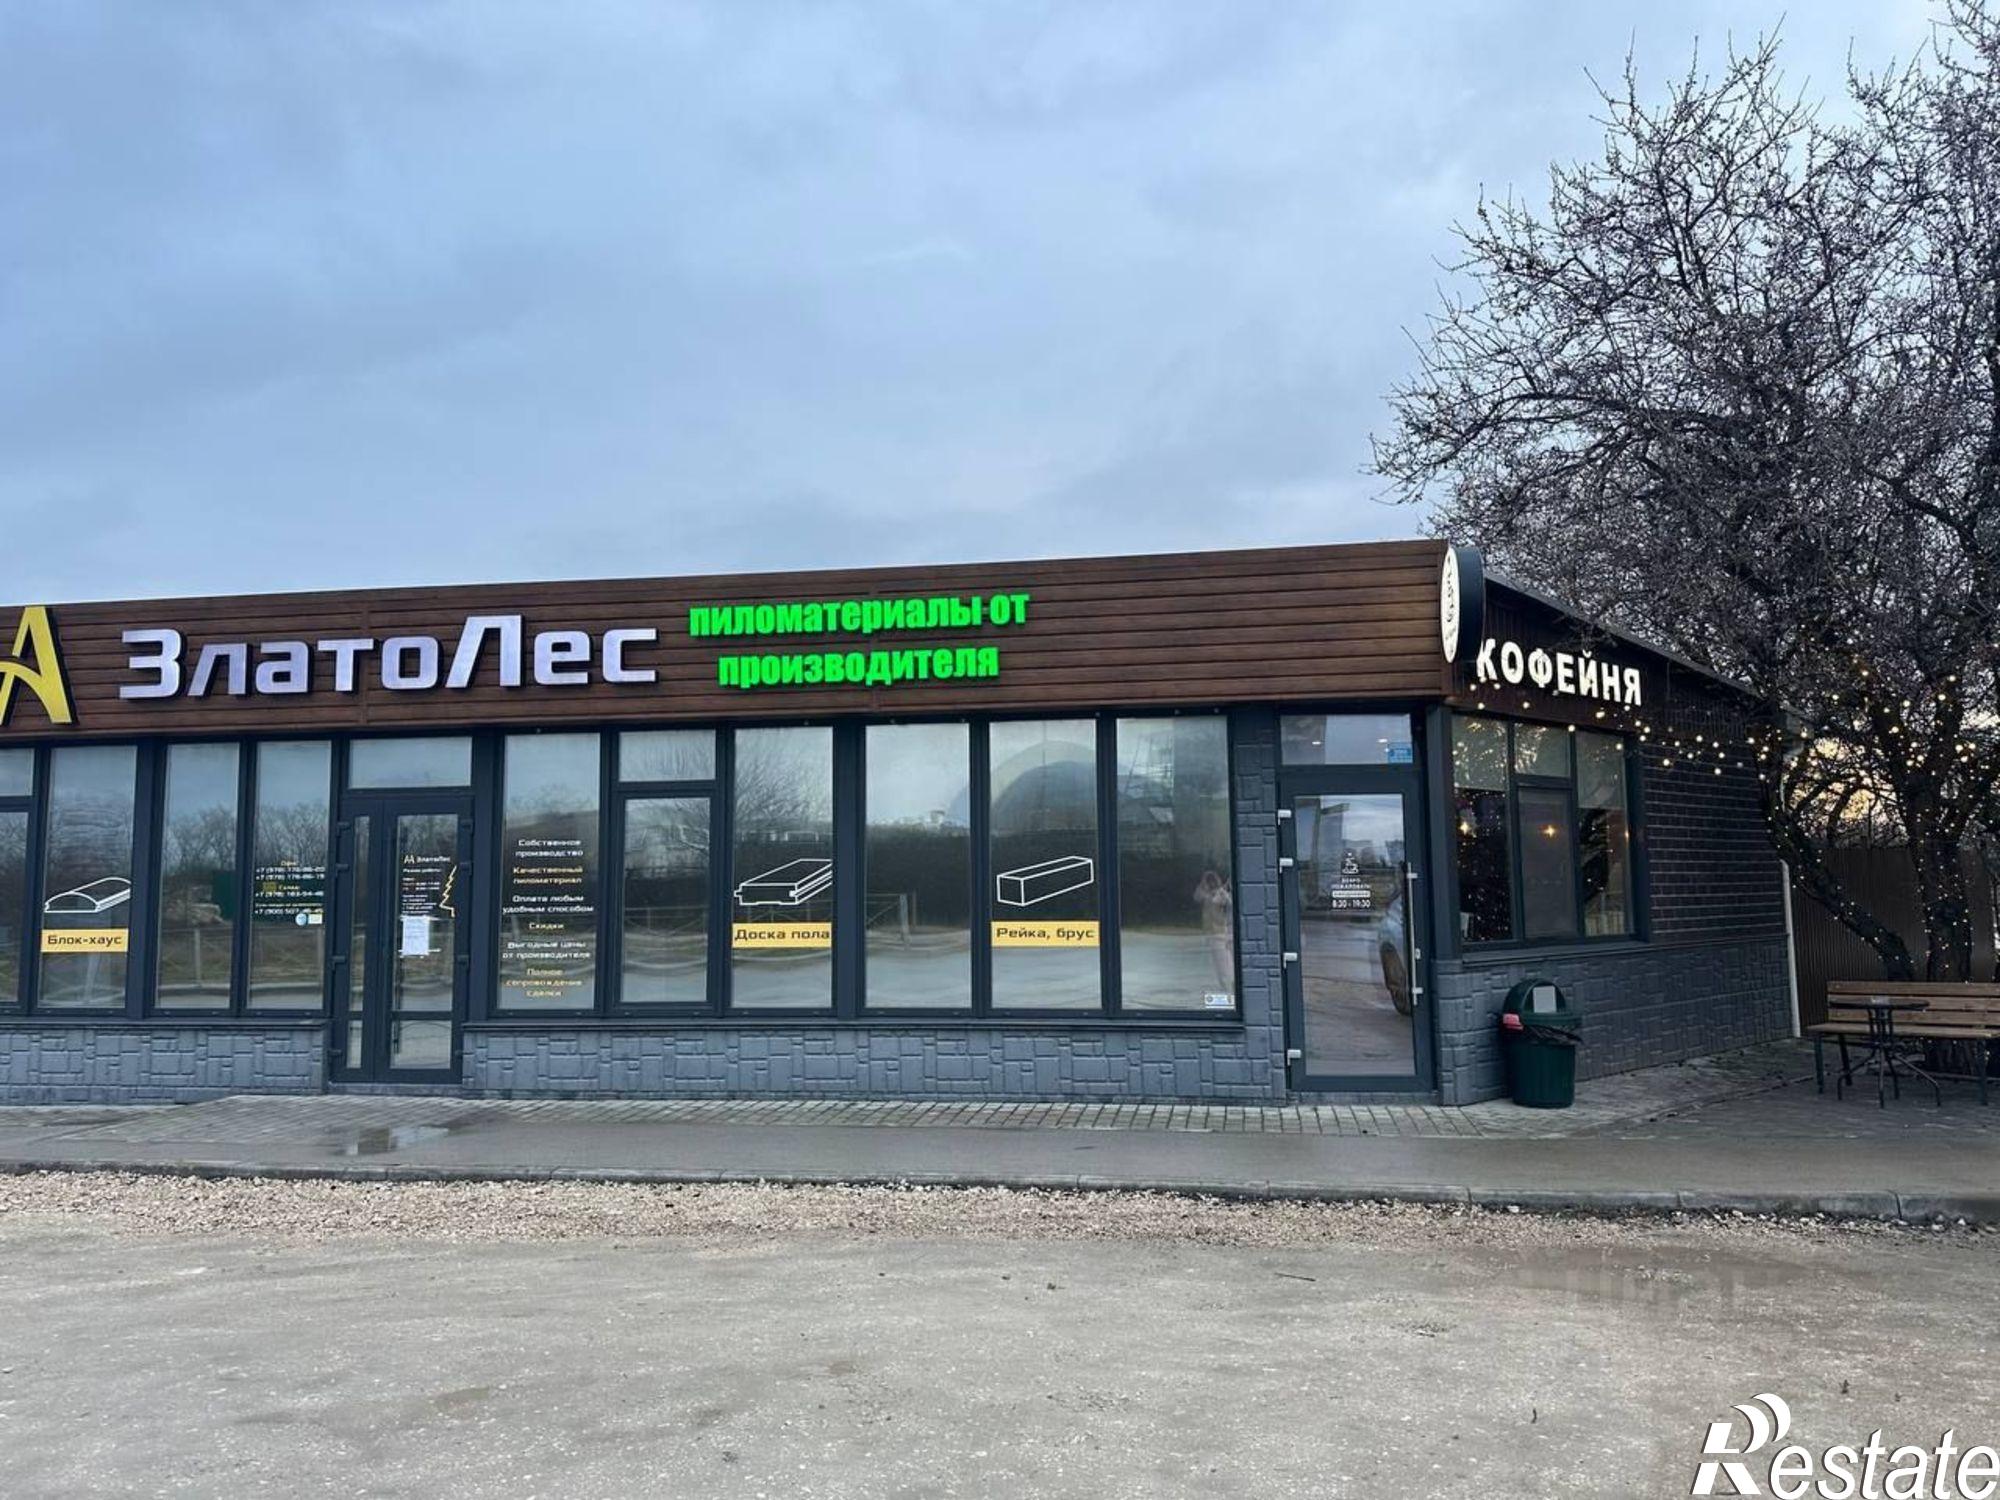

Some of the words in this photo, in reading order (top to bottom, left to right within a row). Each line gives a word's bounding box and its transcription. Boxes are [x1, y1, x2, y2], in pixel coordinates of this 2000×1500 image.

[688, 595, 983, 634] пиломатериалы
[988, 593, 1031, 626] от
[118, 613, 657, 699] ЗлатоЛес
[717, 646, 1000, 689] производителя
[1475, 637, 1643, 707] КОФЕЙНЯ
[517, 839, 582, 847] Собственное
[514, 850, 584, 859] производство
[513, 865, 584, 875] Качественный
[512, 894, 548, 903] Оплата
[549, 894, 584, 902] любым
[502, 906, 546, 915] удобным
[547, 905, 595, 914] способом
[528, 921, 564, 930] Скидки
[735, 928, 786, 941] Доска
[791, 930, 831, 940] пола
[995, 927, 1051, 940] Рейка,
[1056, 928, 1096, 941] брус
[47, 934, 123, 948] Блок-хаус
[507, 941, 558, 950] Выгодные
[516, 952, 591, 960] производителя
